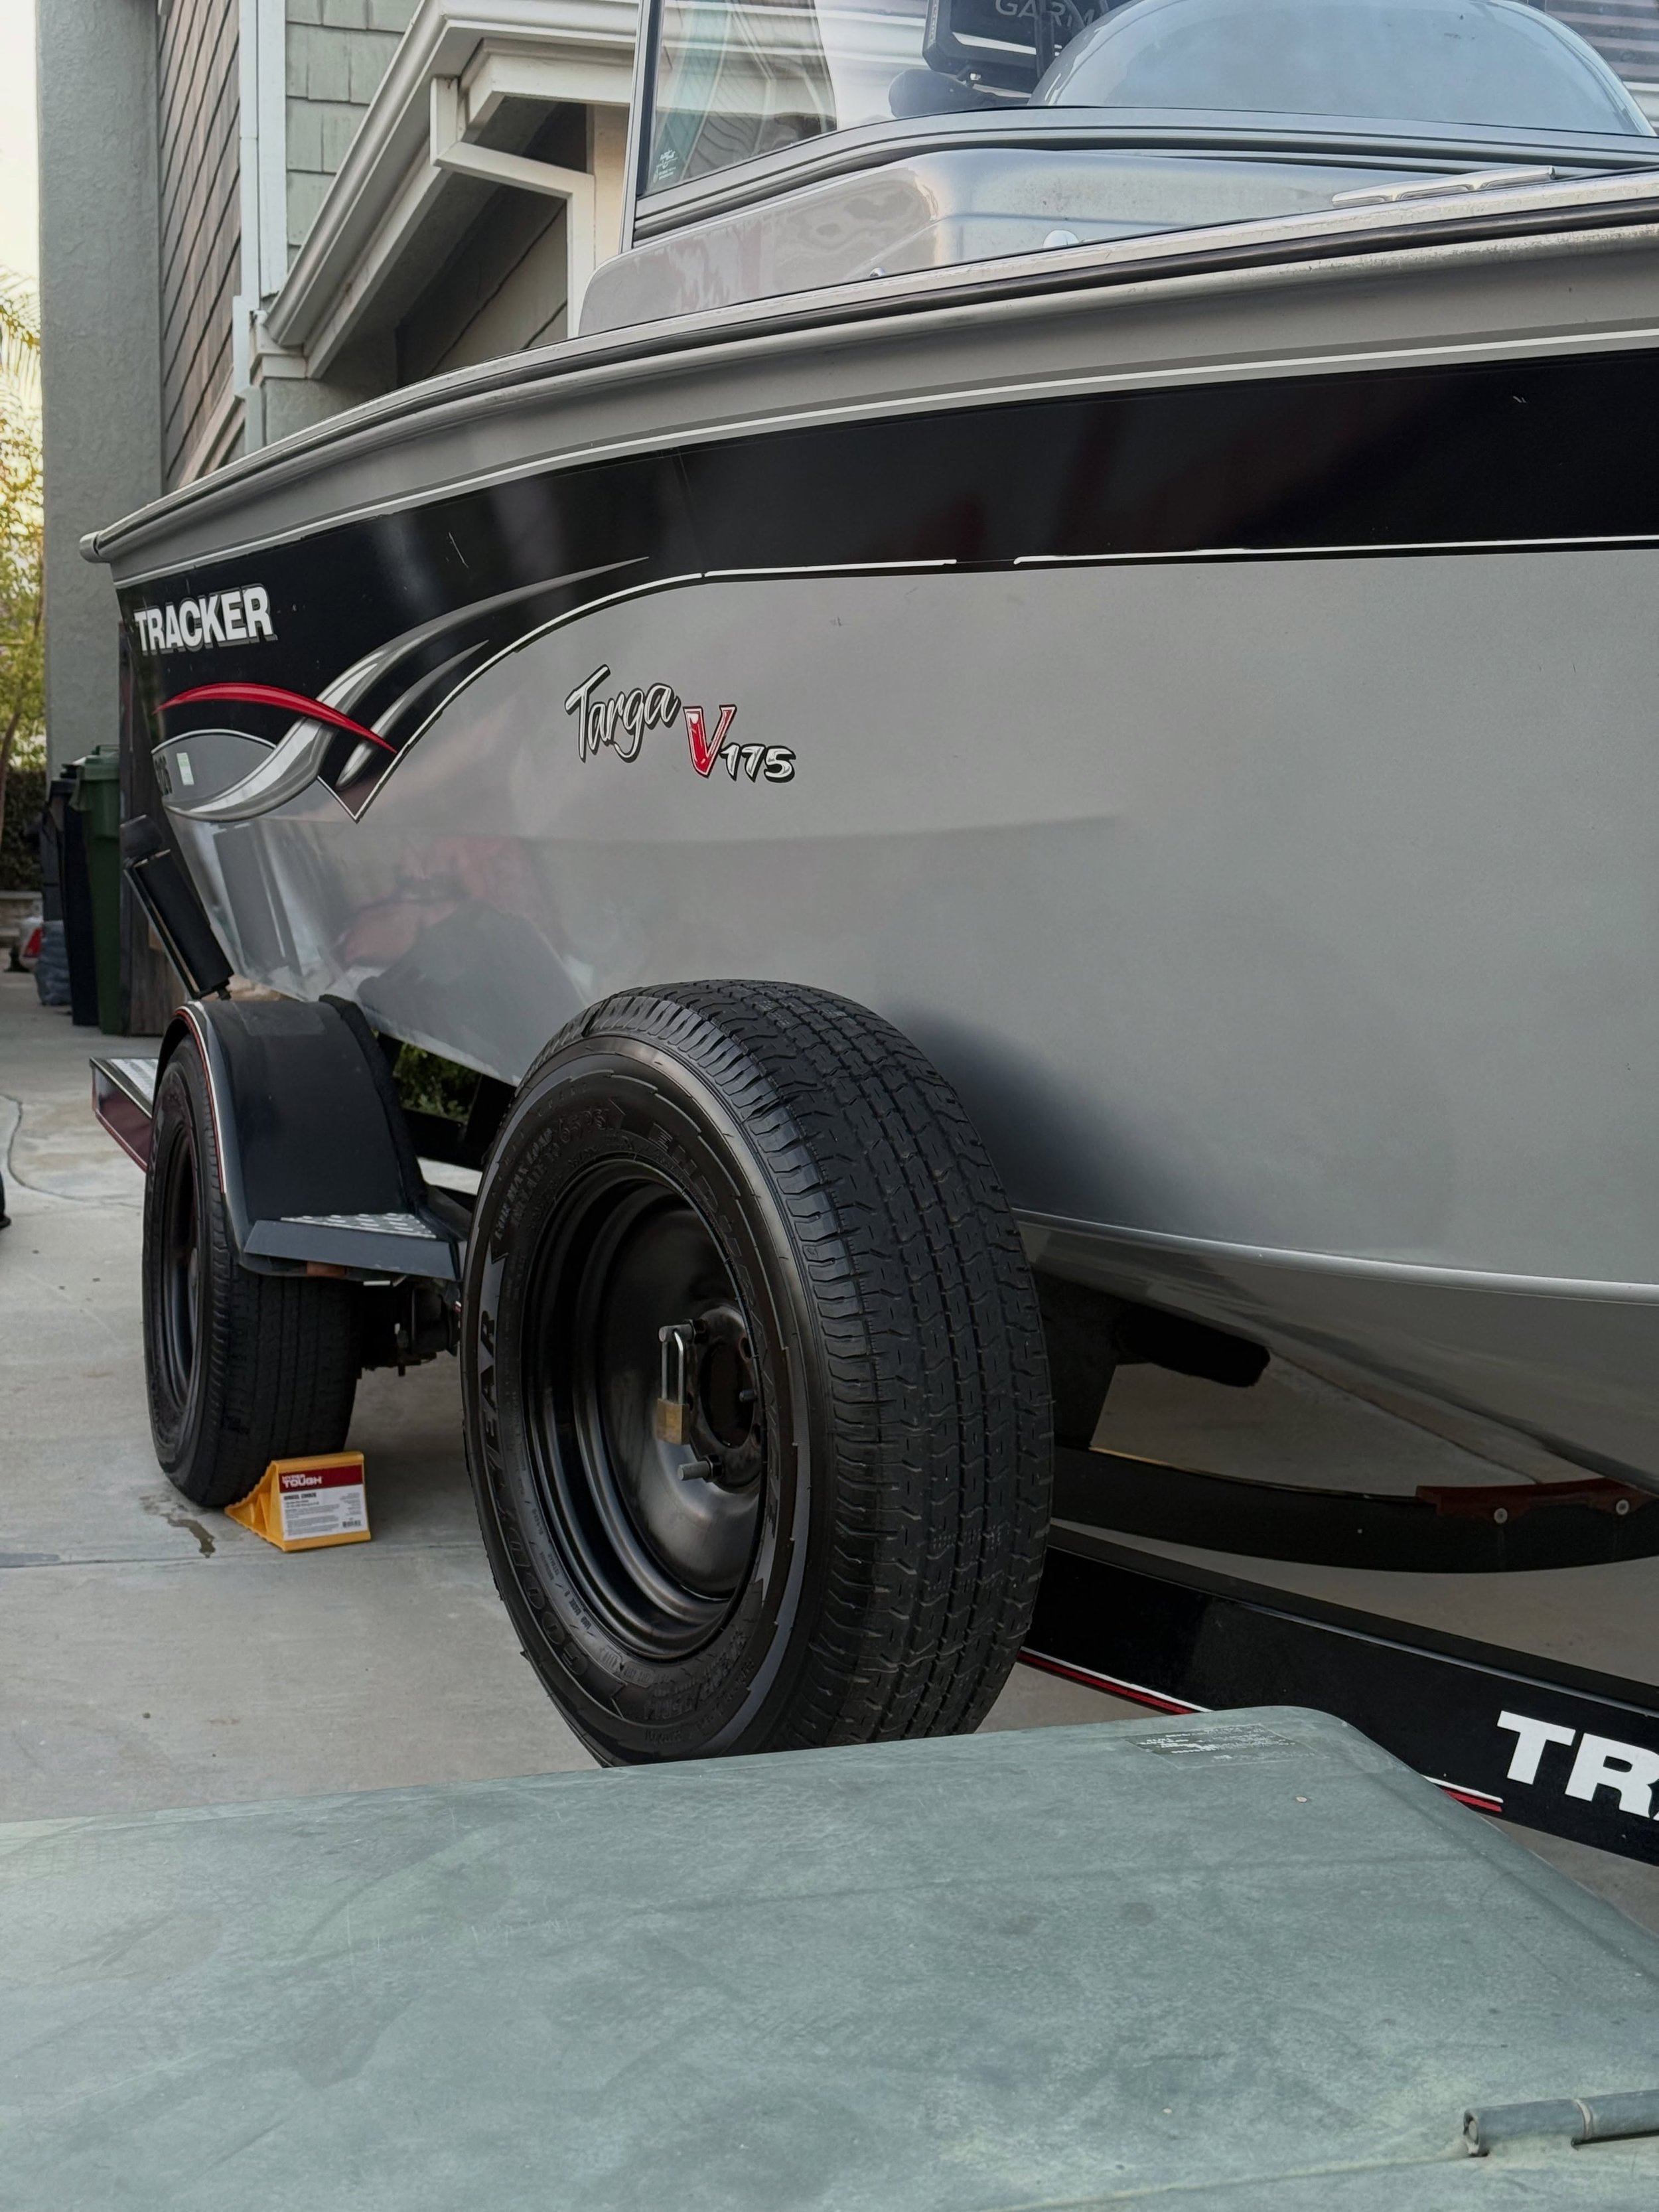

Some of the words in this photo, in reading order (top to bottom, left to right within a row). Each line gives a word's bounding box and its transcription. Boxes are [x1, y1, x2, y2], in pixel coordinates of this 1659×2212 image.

[133, 584, 277, 654] TRACKER
[564, 664, 682, 763] Targa
[284, 1476, 323, 1489] TOUGH
[1496, 1710, 1659, 1821] TR
